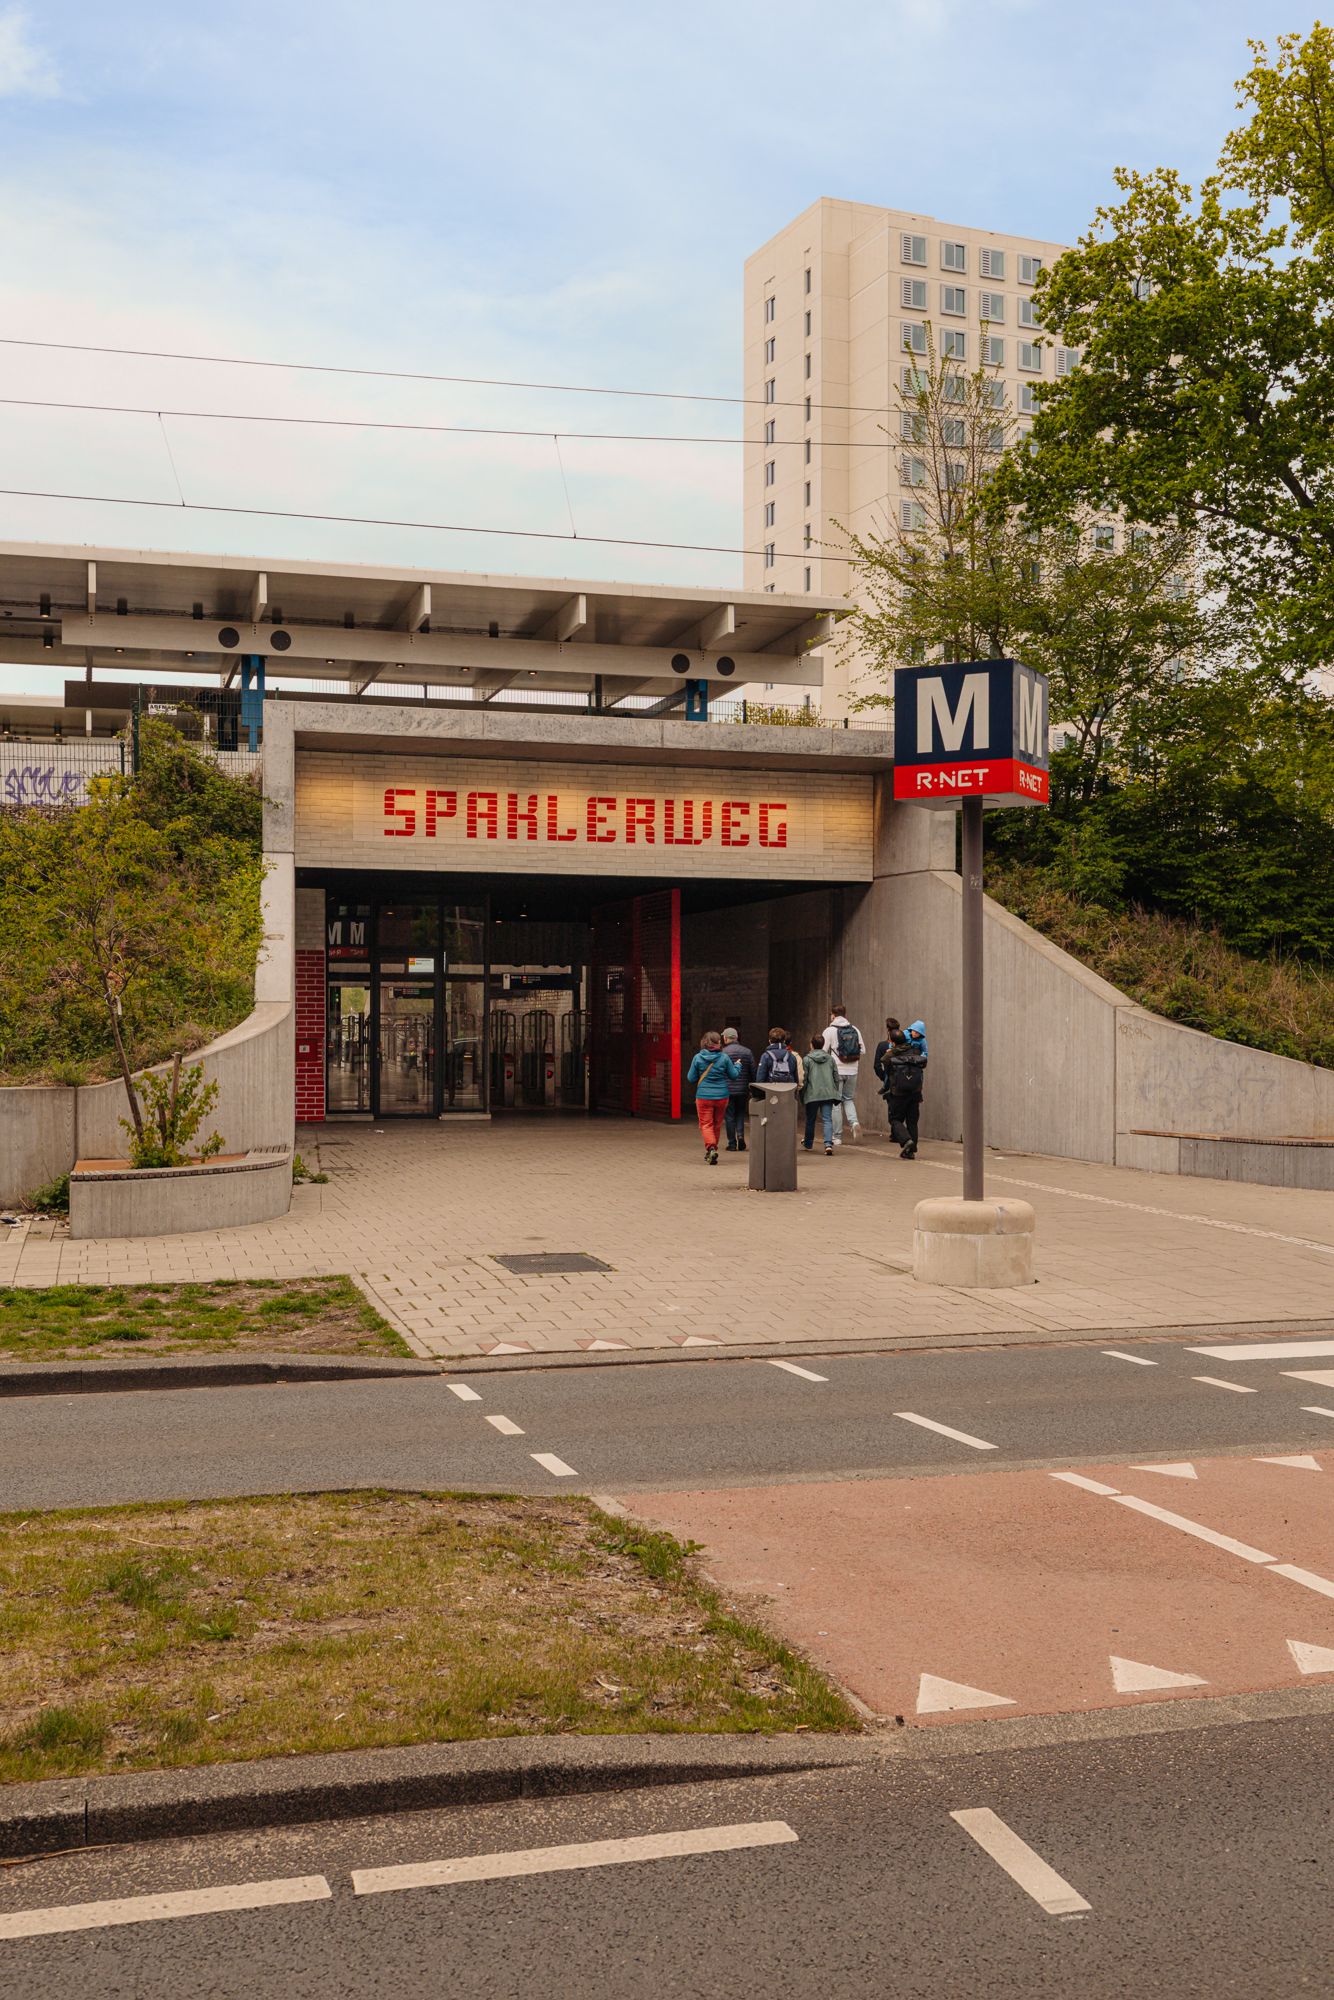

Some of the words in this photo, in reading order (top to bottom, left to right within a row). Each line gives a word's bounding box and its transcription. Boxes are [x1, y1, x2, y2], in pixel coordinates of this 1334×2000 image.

[917, 672, 990, 754] M
[1019, 674, 1043, 758] M
[384, 788, 788, 848] SPAKLERWEG
